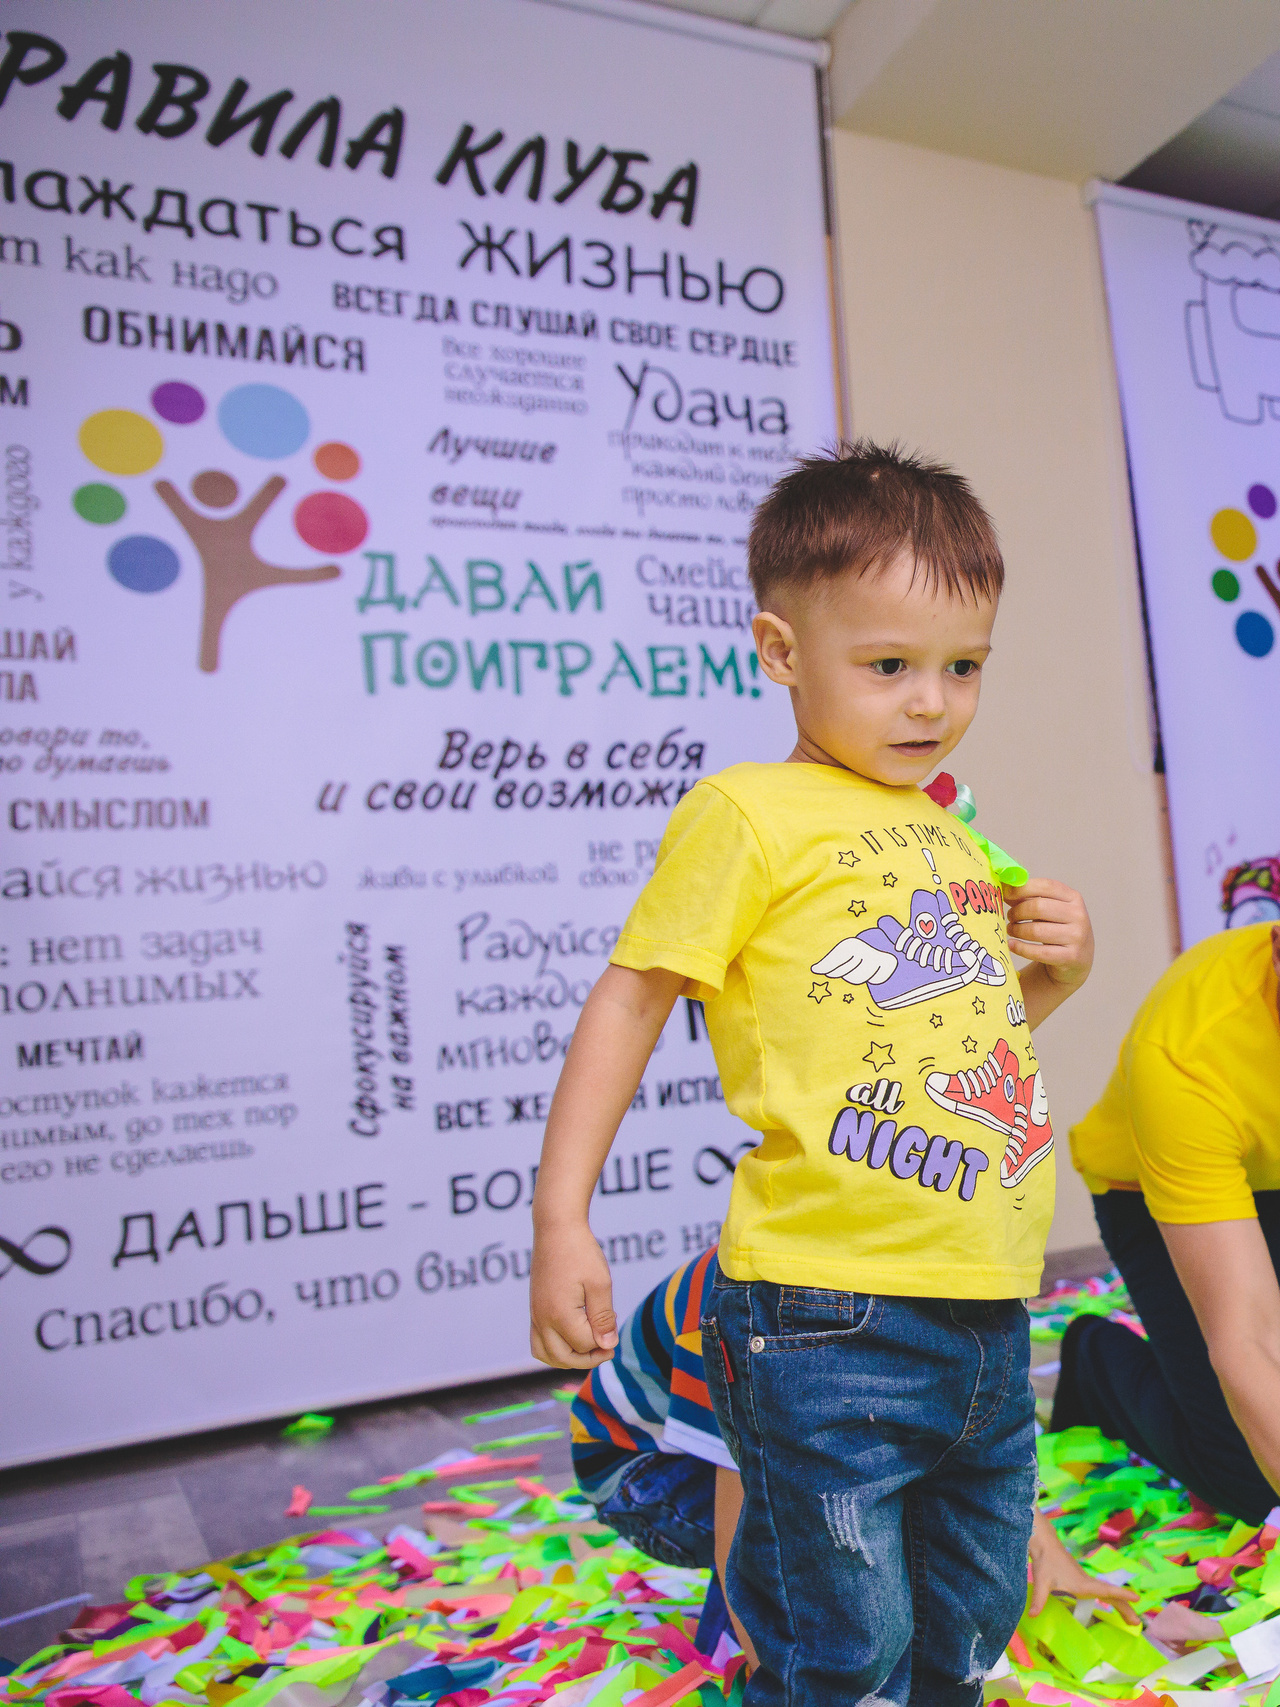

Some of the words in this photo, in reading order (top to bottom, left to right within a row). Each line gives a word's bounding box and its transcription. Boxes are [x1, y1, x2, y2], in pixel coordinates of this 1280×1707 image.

[436, 122, 699, 227] КЛУБА
[458, 219, 785, 314] ЖИЗНЬЮ
[82, 305, 367, 373] ОБНИМАЙСЯ
[332, 281, 459, 325] ВСЕГДА
[470, 298, 597, 341] СЛУШАЙ
[610, 316, 683, 353] СВОЕ
[689, 326, 798, 368] СЕРДЦЕ
[427, 427, 558, 463] Лучшие
[429, 482, 523, 518] вещи
[357, 551, 604, 618] ДАВАЙ
[636, 554, 752, 591] Смейс
[360, 630, 762, 698] ПОИГРАЕМ!
[438, 729, 547, 781] Верь
[566, 740, 589, 770] в
[606, 726, 706, 771] себя
[8, 797, 211, 832] СМЫСЛОМ
[317, 780, 348, 813] и
[366, 780, 477, 813] свои
[860, 829, 885, 856] IT
[882, 826, 909, 848] IS
[904, 823, 952, 848] TIME
[455, 969, 594, 1016] каждо
[16, 1029, 146, 1070] МЕЧТАЙ
[434, 1098, 495, 1133] ВСЕ
[845, 1078, 906, 1115] all
[828, 1106, 990, 1202] NIGHT
[111, 1182, 387, 1268] ДАЛЬШЕ
[449, 1147, 674, 1216] БОШЕ
[34, 1280, 277, 1353] Спасибо,
[293, 1266, 400, 1311] что
